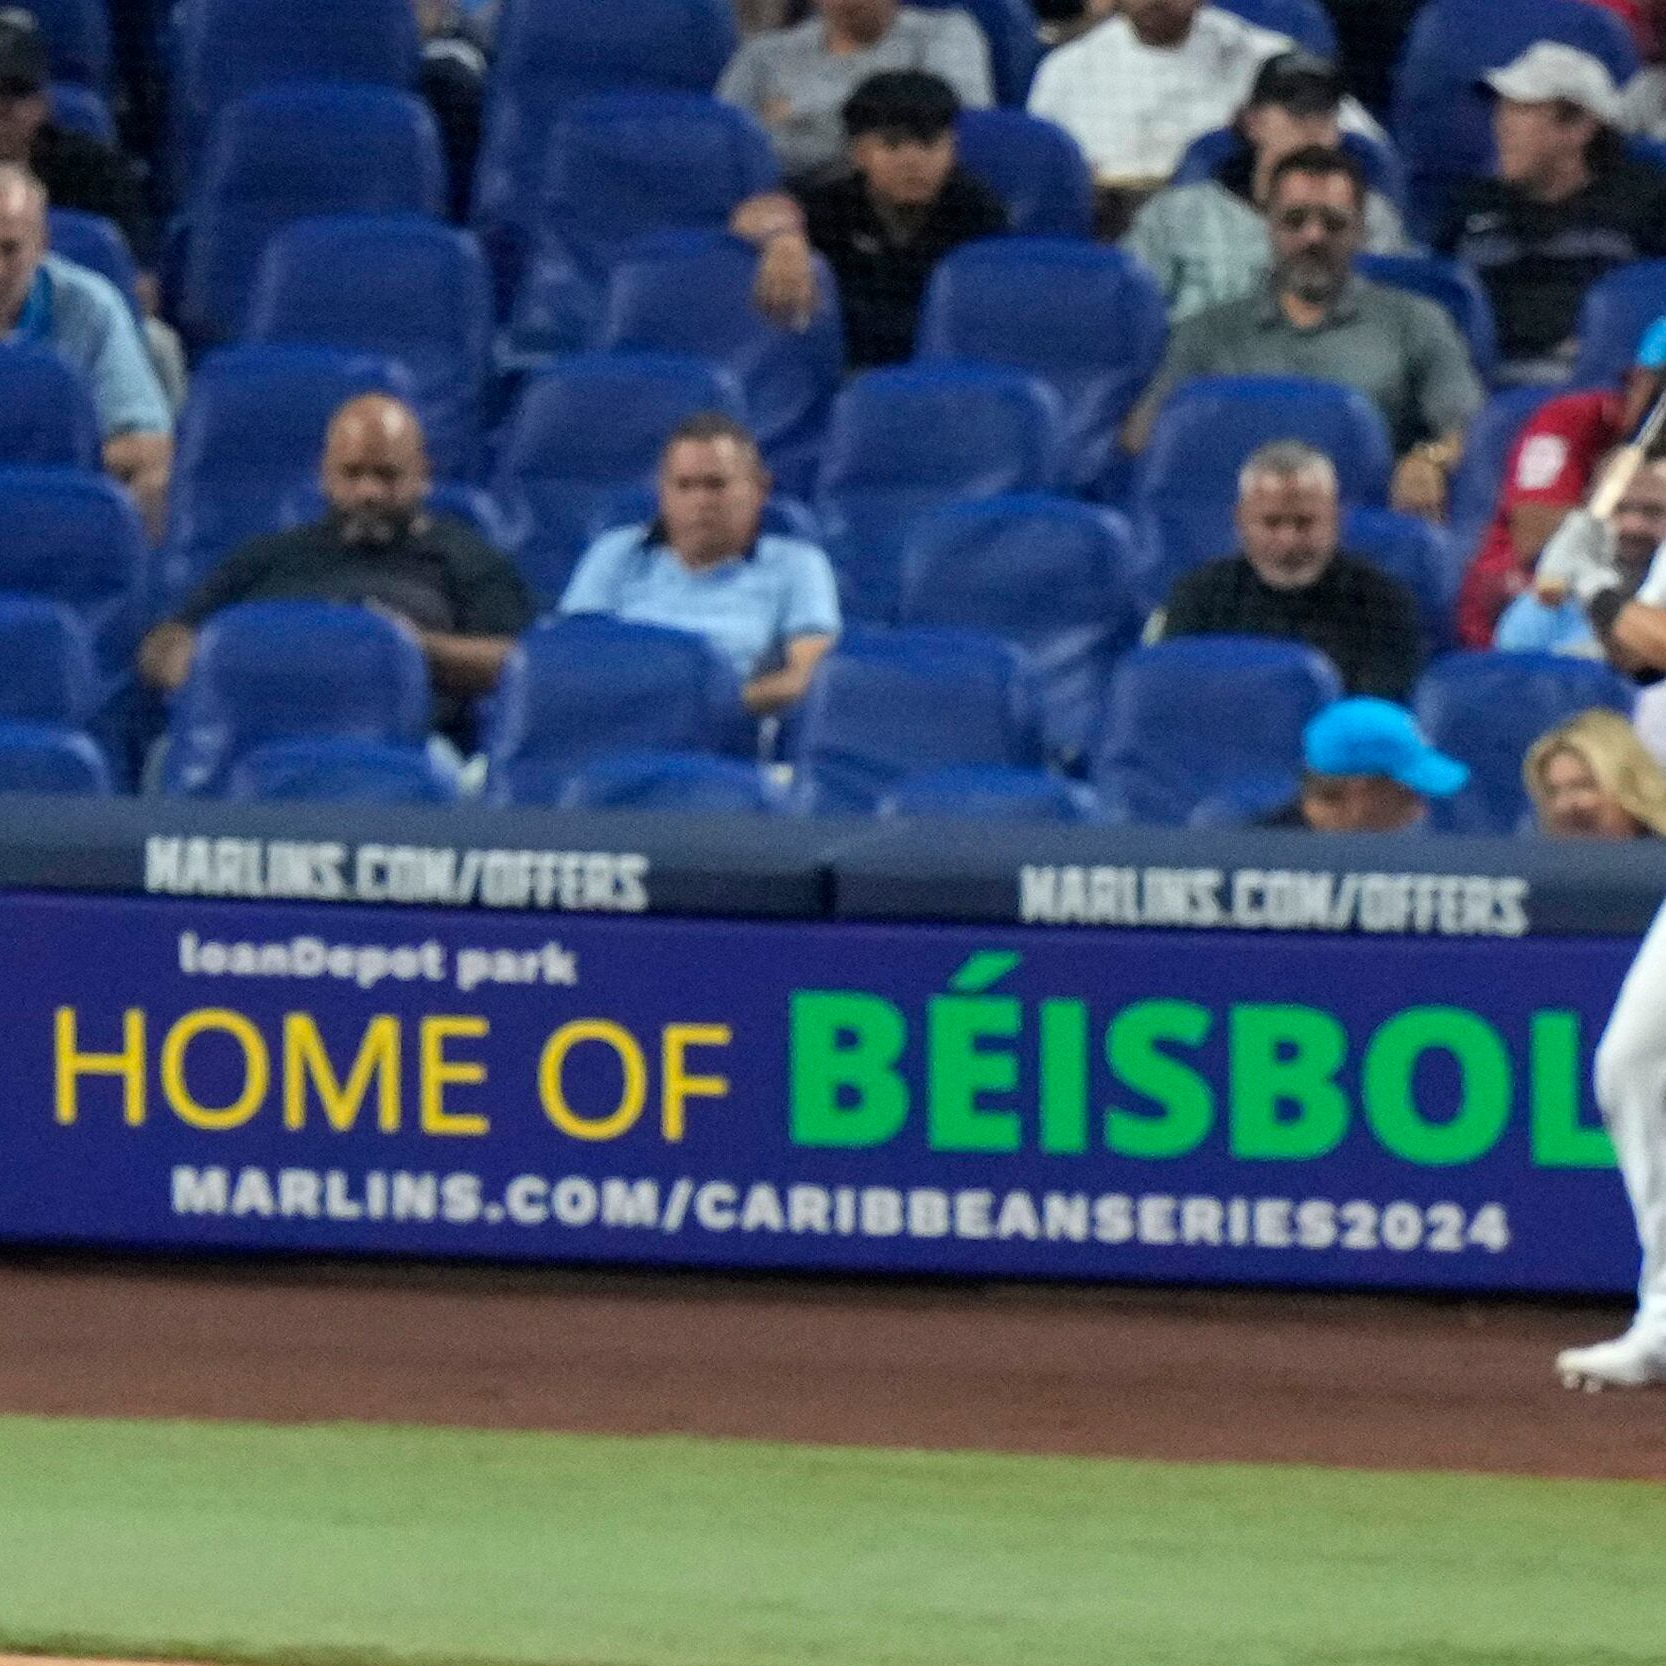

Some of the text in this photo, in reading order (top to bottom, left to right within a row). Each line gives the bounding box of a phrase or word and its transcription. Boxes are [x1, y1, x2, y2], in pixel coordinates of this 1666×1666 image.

[145, 836, 649, 912] MARLINS.COM/OFFERS
[1020, 866, 1529, 936] MARLINS.COM/OFFERS
[179, 930, 577, 990] loanDepot park
[53, 949, 1618, 1169] HOME OF BÉISBOL
[171, 1166, 1510, 1253] MARLINS.COM/CARIBBEANSERIES2024
